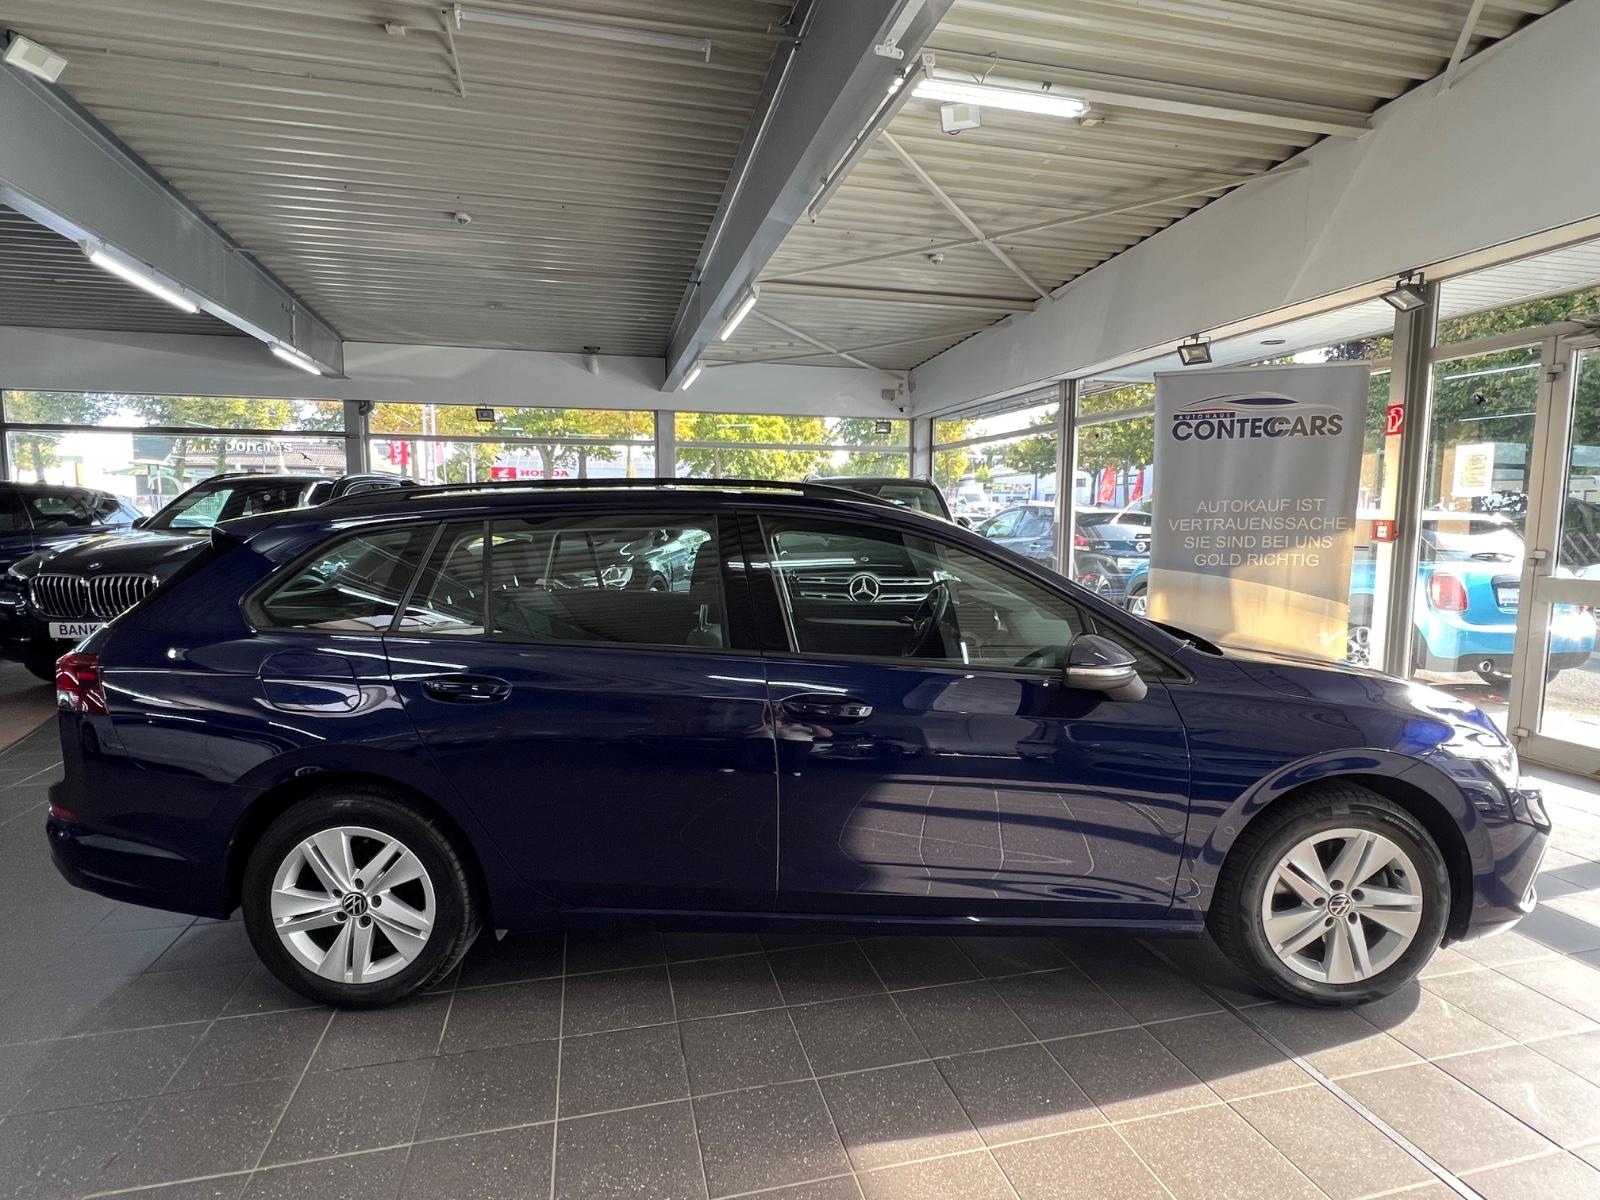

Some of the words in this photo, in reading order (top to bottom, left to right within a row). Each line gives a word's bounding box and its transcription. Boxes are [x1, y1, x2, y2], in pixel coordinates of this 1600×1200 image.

[1178, 412, 1231, 420] AUTOHAUS
[1196, 499, 1292, 513] AUTOKAUF
[1296, 498, 1326, 512] IST
[1168, 517, 1348, 532] VERTRAUENSSACHE
[1184, 536, 1211, 549] SIE
[1215, 535, 1256, 549] SIND
[1261, 535, 1289, 548] BEI
[1295, 535, 1333, 549] UNS
[1194, 553, 1241, 567] GOLD
[1247, 553, 1320, 567] RICHTIG
